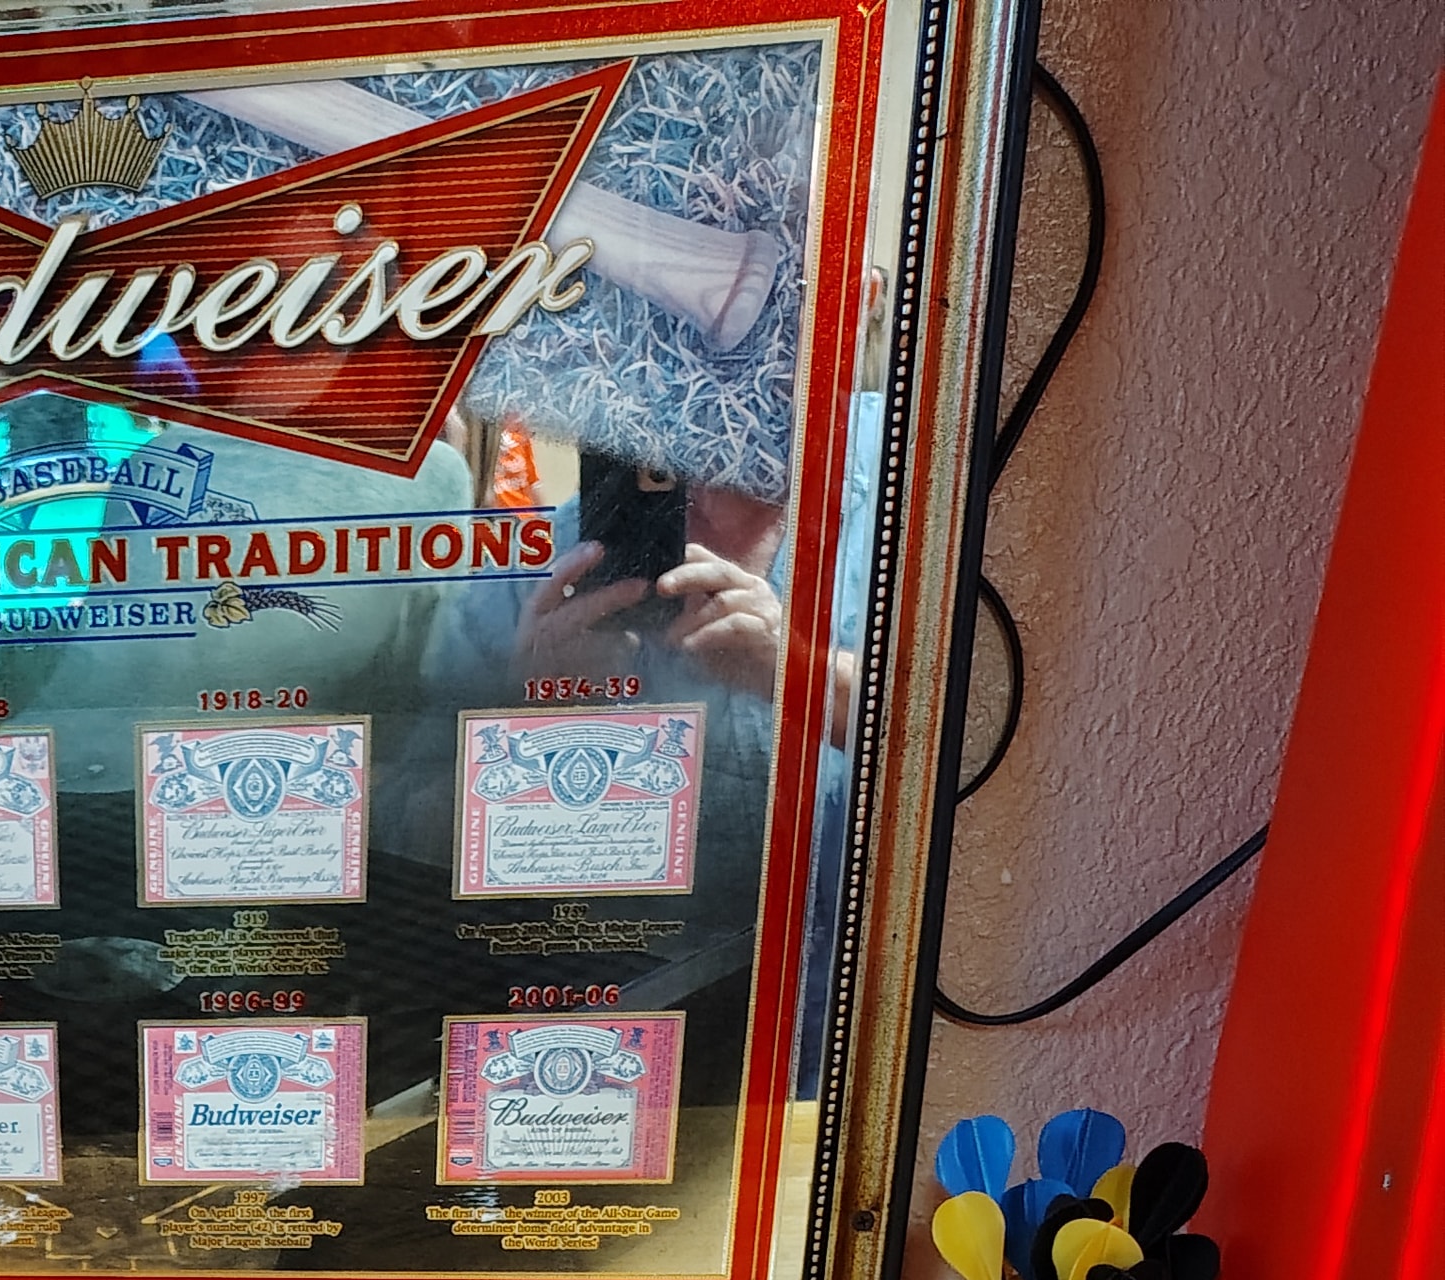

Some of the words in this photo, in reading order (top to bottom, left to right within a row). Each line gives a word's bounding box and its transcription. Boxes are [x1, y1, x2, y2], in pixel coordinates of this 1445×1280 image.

[155, 519, 555, 581] TRADITIONS
[198, 688, 310, 712] 1918-20
[524, 677, 642, 701] 1934-39
[469, 809, 481, 884] GENUINE
[674, 800, 688, 876] GENUINE
[236, 913, 267, 925] 1919
[200, 991, 306, 1013] 1996-99
[508, 985, 620, 1008] 2001-06
[188, 1103, 322, 1126] Budweiser
[489, 1097, 630, 1127] Budweiser
[174, 1095, 184, 1167] GENUINE
[236, 1193, 265, 1204] 1997
[537, 1192, 569, 1203] 2003
[190, 1208, 206, 1218] On
[210, 1207, 235, 1219] April
[269, 1207, 286, 1218] the
[289, 1207, 311, 1218] first
[428, 1208, 448, 1218] The
[453, 1208, 473, 1218] first
[504, 1208, 522, 1218] the
[525, 1208, 564, 1218] winner
[566, 1207, 578, 1218] of
[581, 1207, 599, 1218] the
[602, 1207, 643, 1218] All-Star
[646, 1208, 678, 1218] Game
[162, 1222, 203, 1234] player's
[207, 1222, 247, 1232] number
[276, 1223, 285, 1232] is
[287, 1222, 323, 1232] retired
[327, 1222, 342, 1234] by
[454, 1222, 514, 1233] determines
[518, 1222, 547, 1233] home
[550, 1222, 576, 1233] field
[579, 1222, 635, 1235] advantage
[638, 1223, 650, 1233] in
[192, 1237, 223, 1248] Major
[225, 1237, 261, 1248] League
[504, 1237, 522, 1247] the
[525, 1237, 559, 1247] World
